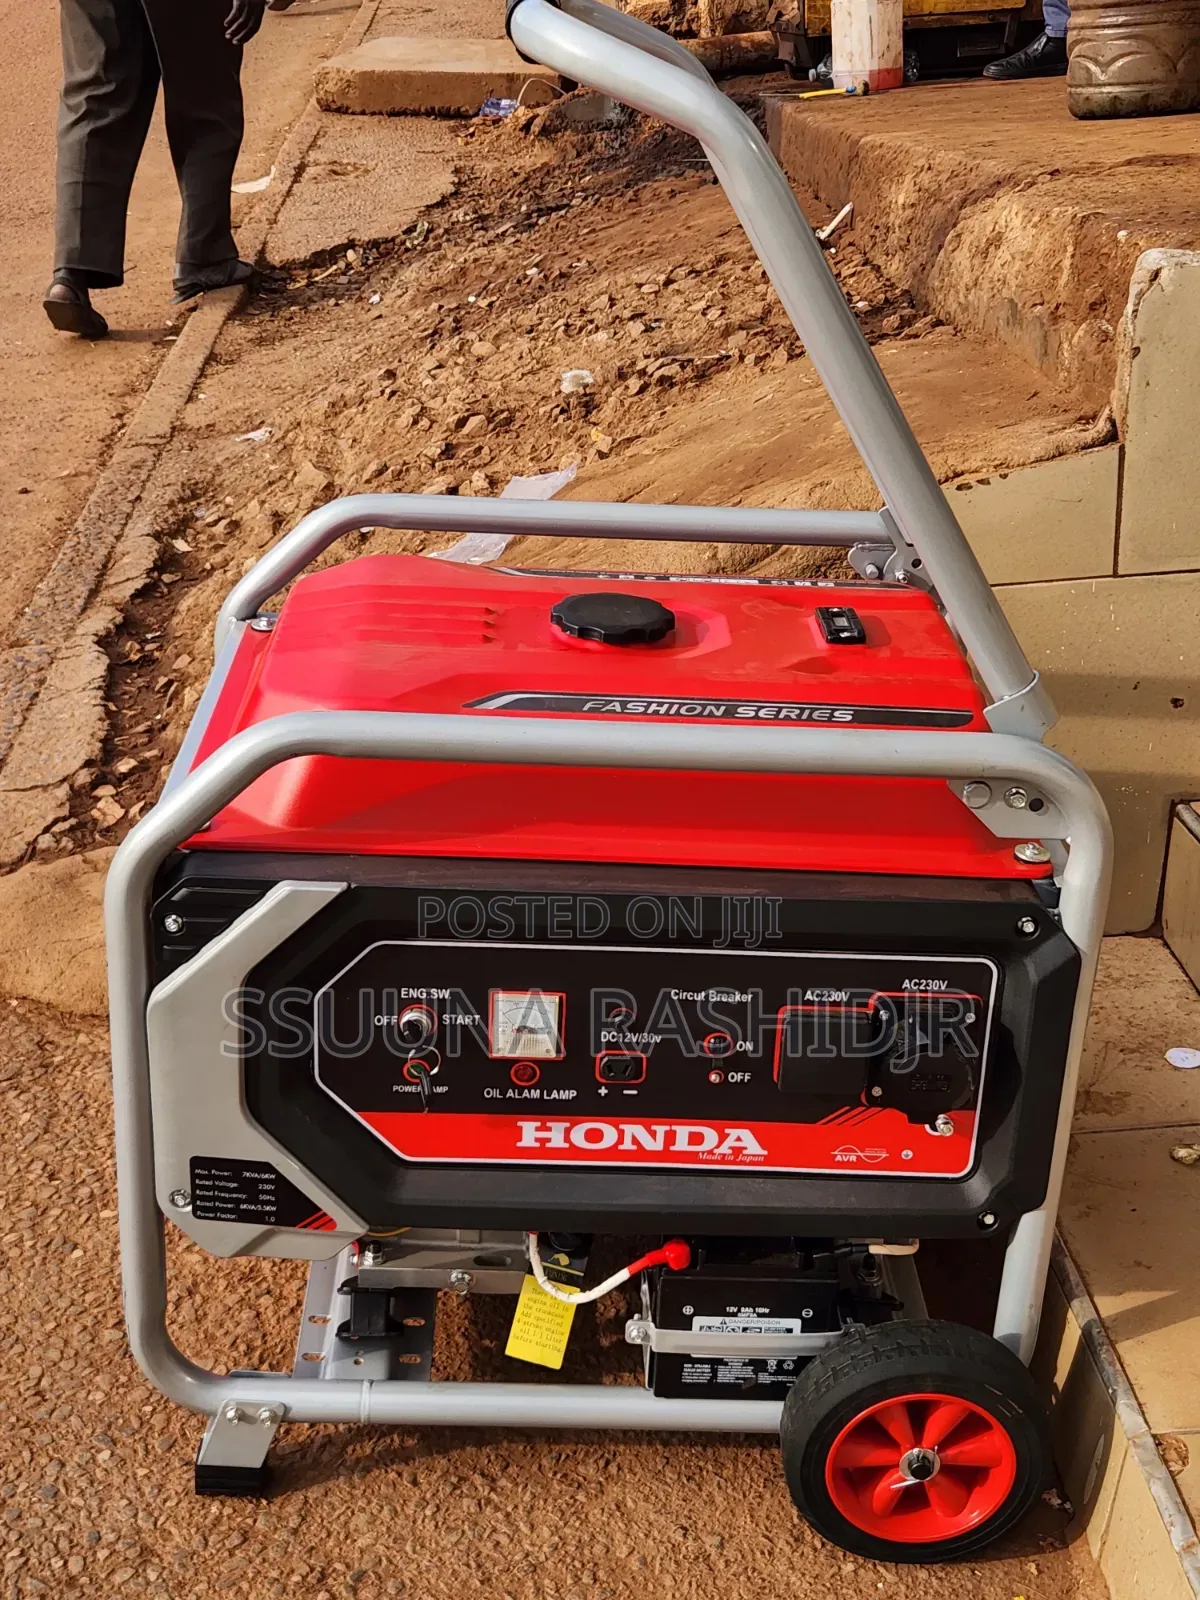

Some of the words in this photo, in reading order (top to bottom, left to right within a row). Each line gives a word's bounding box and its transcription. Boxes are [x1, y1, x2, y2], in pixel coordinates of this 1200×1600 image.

[582, 699, 725, 718] FASHION
[733, 705, 854, 723] SERIES
[901, 979, 948, 991] AC230V
[670, 988, 705, 1001] Circut
[708, 989, 753, 1003] Breaker
[804, 989, 850, 1003] AC230V
[374, 1014, 398, 1027] OFF
[442, 1014, 481, 1027] START
[736, 1040, 754, 1052] ON
[728, 1071, 752, 1083] OFF
[431, 1085, 449, 1093] AMP
[484, 1087, 504, 1100] OIL
[506, 1088, 541, 1100] ALAM
[543, 1089, 577, 1101] LAMP
[516, 1121, 769, 1155] HONDA
[697, 1152, 723, 1161] Made
[725, 1152, 734, 1161] in
[736, 1153, 765, 1163] Japan
[834, 1154, 857, 1162] AVR
[195, 1178, 213, 1186] Rated
[196, 1199, 214, 1207] Rated
